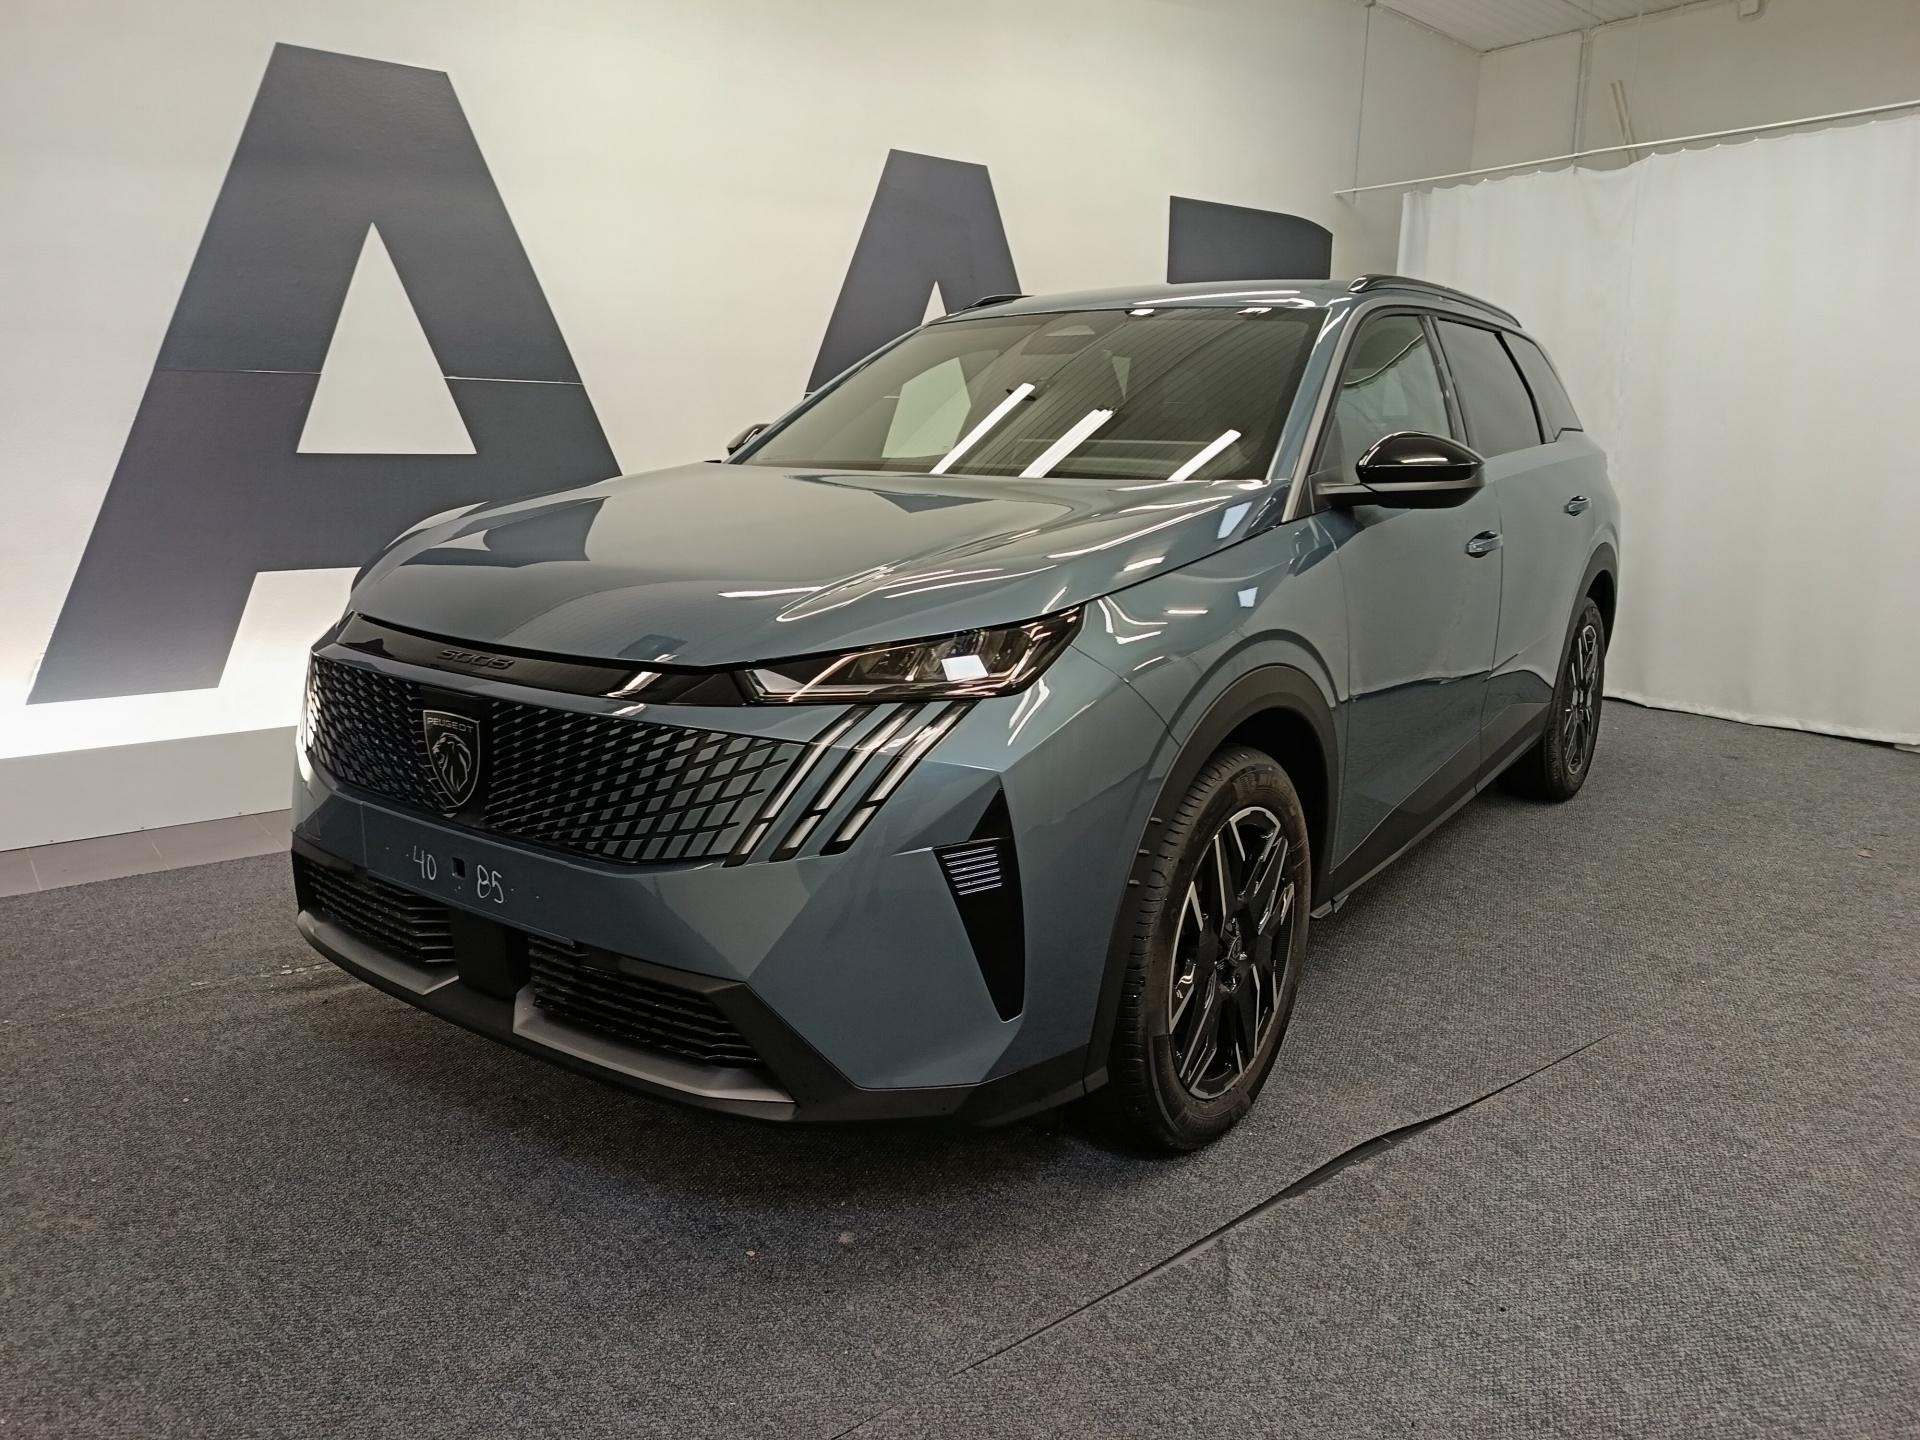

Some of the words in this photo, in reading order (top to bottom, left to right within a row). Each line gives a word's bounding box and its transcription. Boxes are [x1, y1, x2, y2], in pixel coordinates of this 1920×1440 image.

[426, 717, 474, 733] PEUGEOT
[413, 845, 437, 881] 40
[477, 864, 504, 904] 85
